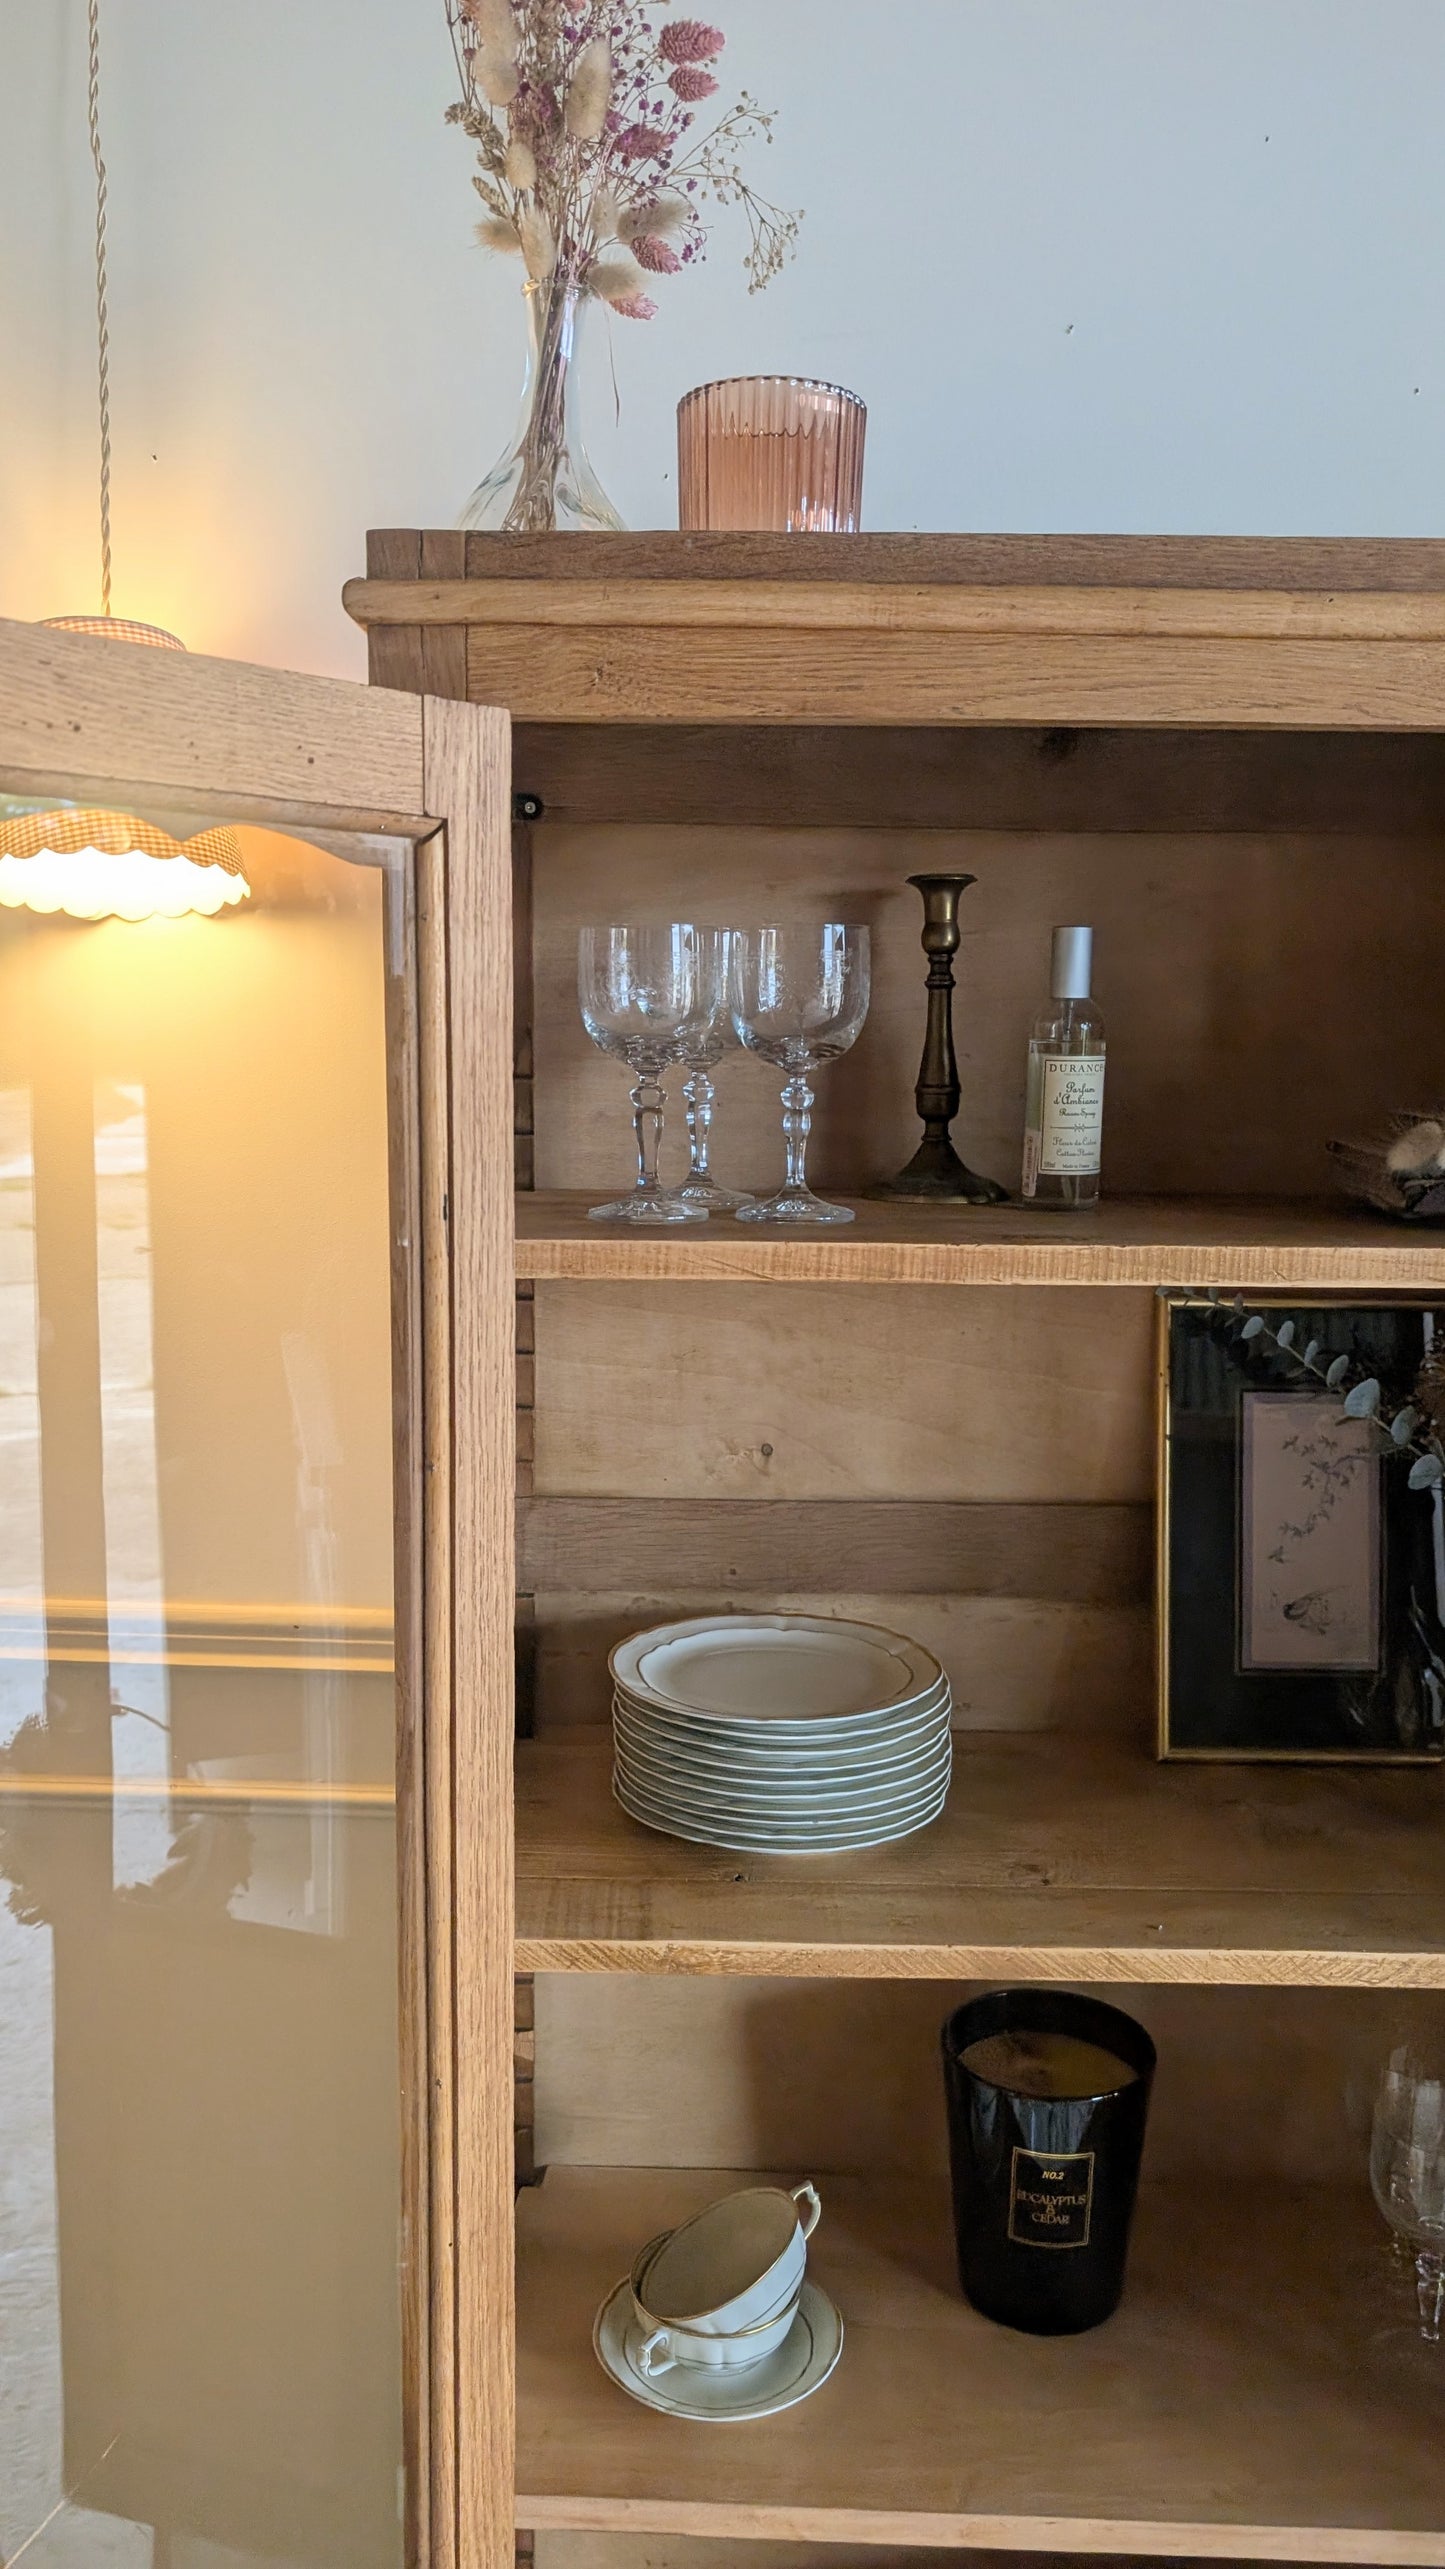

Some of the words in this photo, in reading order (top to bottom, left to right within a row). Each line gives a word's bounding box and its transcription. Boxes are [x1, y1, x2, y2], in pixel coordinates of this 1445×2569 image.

[1049, 1064, 1104, 1073] DURANCE
[1066, 1082, 1095, 1096] Parfum
[1053, 1092, 1099, 1105] d'Ambiance
[1042, 2171, 1065, 2180] NO.2
[1016, 2189, 1087, 2206] EUCALYPTUS
[1031, 2212, 1070, 2225] CEDAR
